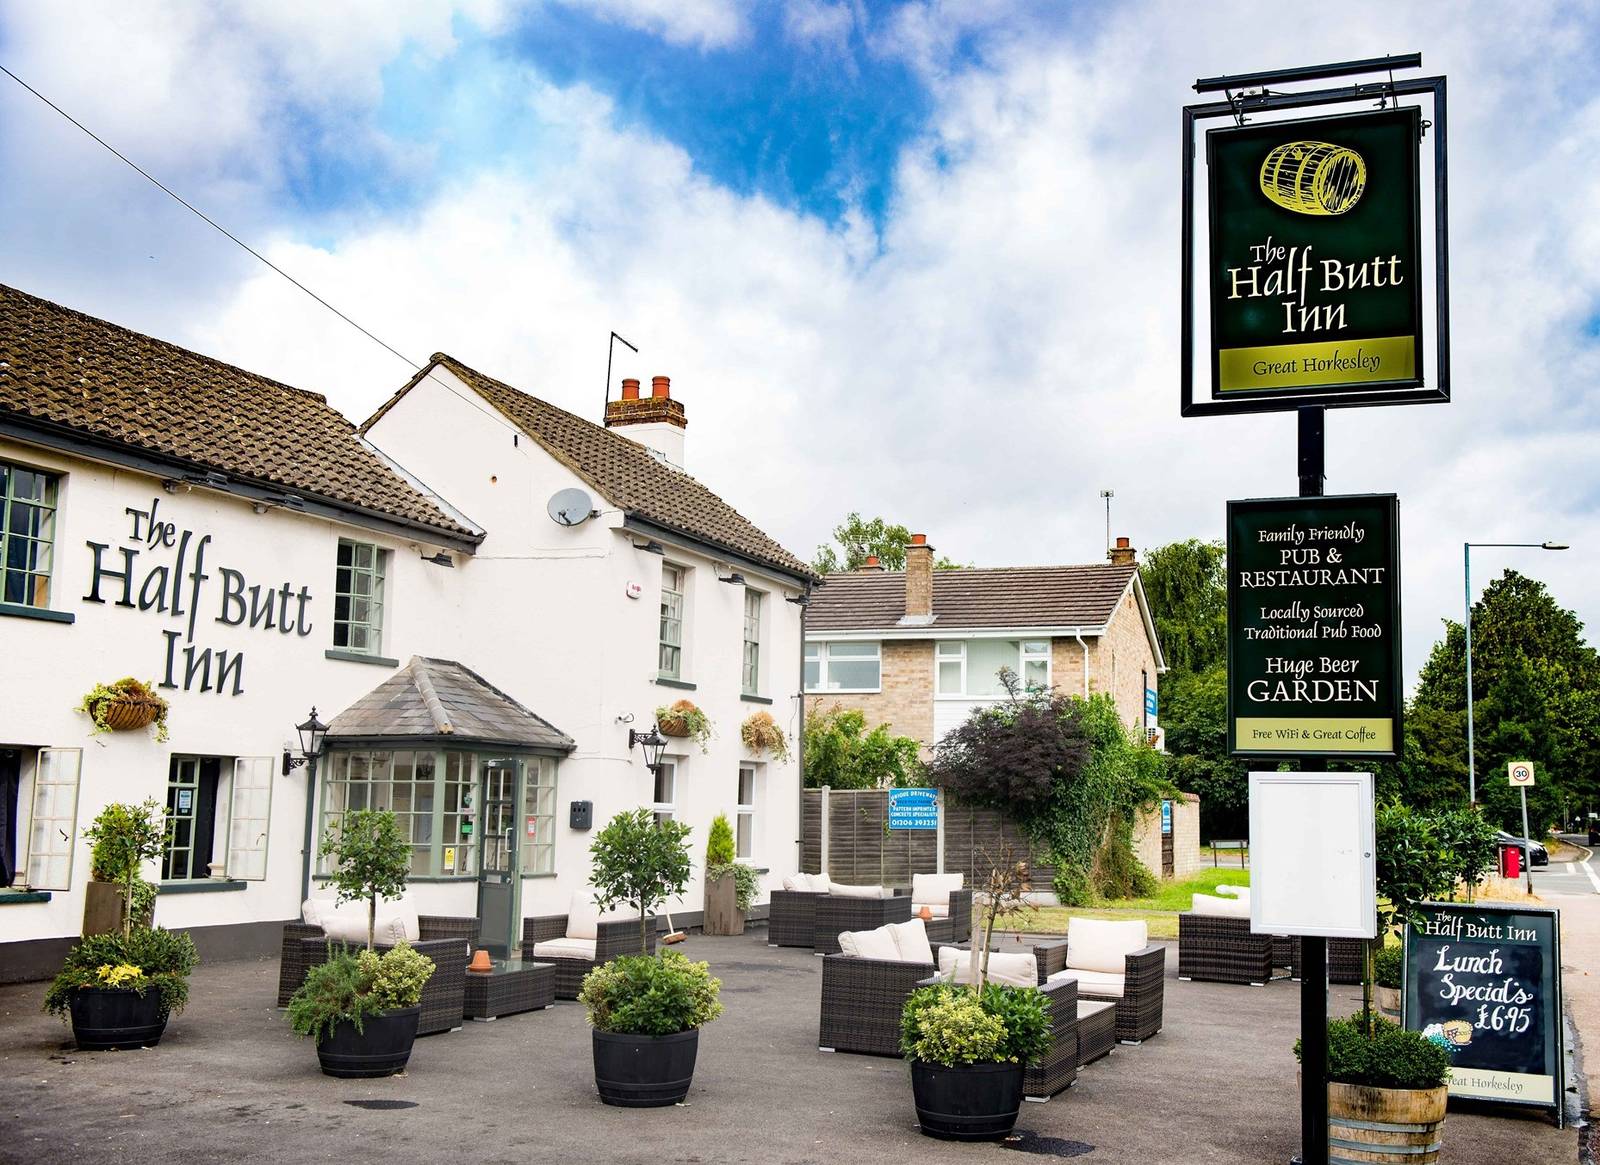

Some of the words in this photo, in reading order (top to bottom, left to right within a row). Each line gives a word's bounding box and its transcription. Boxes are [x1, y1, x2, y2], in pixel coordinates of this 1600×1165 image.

[1250, 236, 1286, 264] The
[1227, 245, 1312, 307] Half
[1319, 254, 1403, 292] Butt
[1282, 301, 1348, 333] Inn
[1252, 360, 1298, 376] Great
[1302, 348, 1381, 374] Horkesley
[125, 498, 176, 551] The
[1258, 523, 1305, 545] Family
[1308, 521, 1365, 543] Friendly
[1280, 548, 1320, 565] PUB
[1326, 547, 1343, 564] &
[82, 530, 212, 643] Half
[214, 566, 313, 637] Butt
[1240, 567, 1385, 588] RESTAURANT
[1260, 600, 1310, 622] Locally
[1313, 603, 1364, 619] Sourced
[1244, 621, 1318, 640] Traditional
[1322, 620, 1347, 639] Pub
[1351, 623, 1382, 638] Food
[158, 629, 244, 697] Inn
[1265, 657, 1314, 679] Huge
[1319, 657, 1360, 674] Beer
[1247, 679, 1379, 704] GARDEN
[1252, 728, 1273, 739] Free
[1275, 728, 1299, 739] WiFi
[1301, 729, 1311, 739] &
[1313, 729, 1343, 740] Great
[1345, 726, 1376, 743] Coffee
[1515, 770, 1527, 778] 30
[1434, 910, 1452, 922] The
[1425, 916, 1464, 942] Half
[1465, 923, 1503, 940] Butt
[1506, 925, 1538, 942] Inn
[1433, 945, 1503, 974] Lunch
[1471, 1075, 1523, 1094] Horkesley
